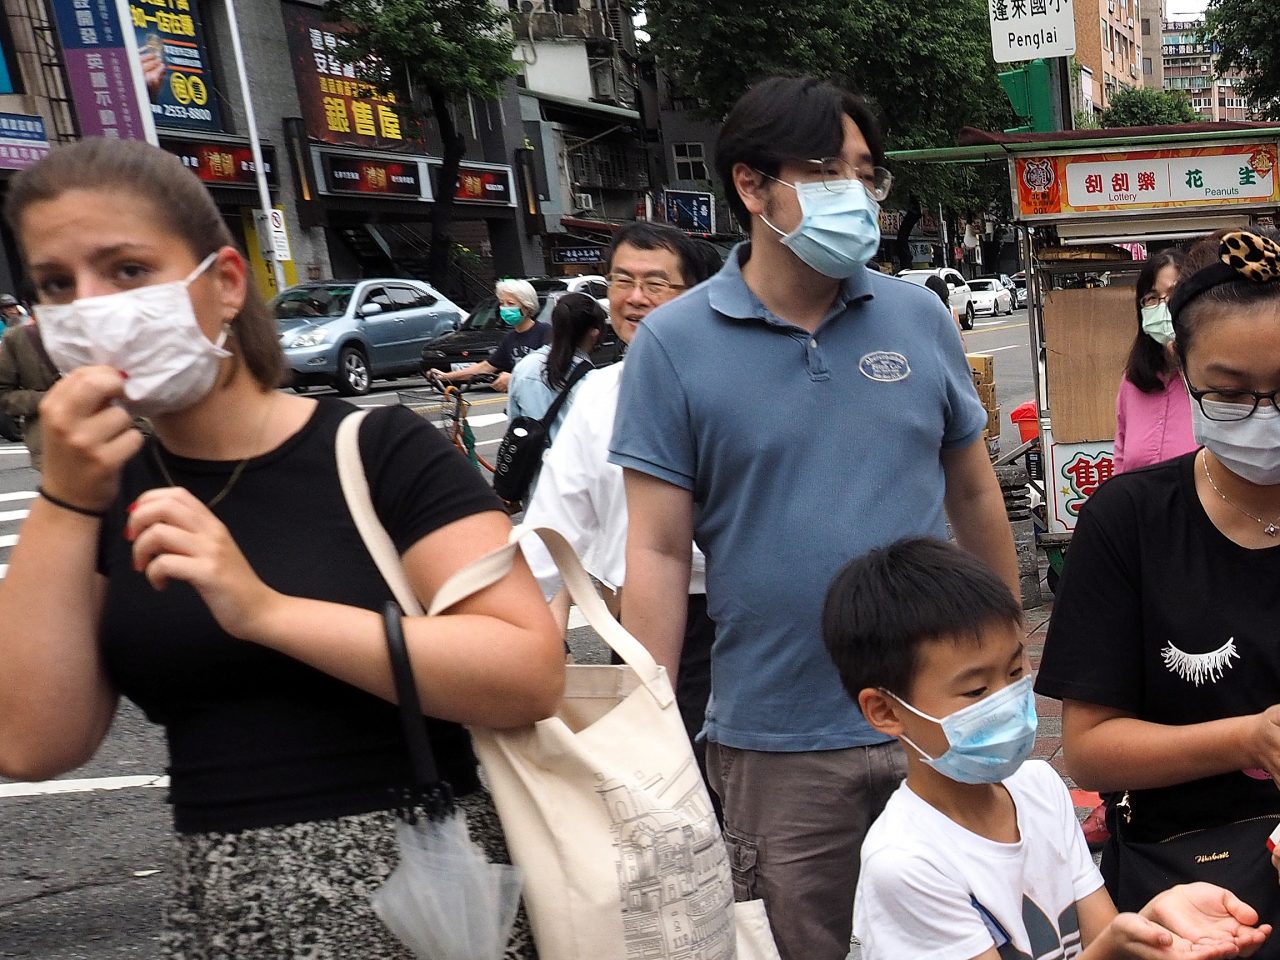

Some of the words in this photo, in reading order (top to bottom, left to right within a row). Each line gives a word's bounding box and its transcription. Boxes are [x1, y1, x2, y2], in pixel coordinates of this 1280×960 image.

[992, 0, 1067, 21] 蓬萊國小
[1008, 27, 1057, 49] Penglai
[1085, 171, 1156, 193] 刮刮樂
[1205, 187, 1239, 197] Peanuts
[1108, 191, 1137, 202] Lottery
